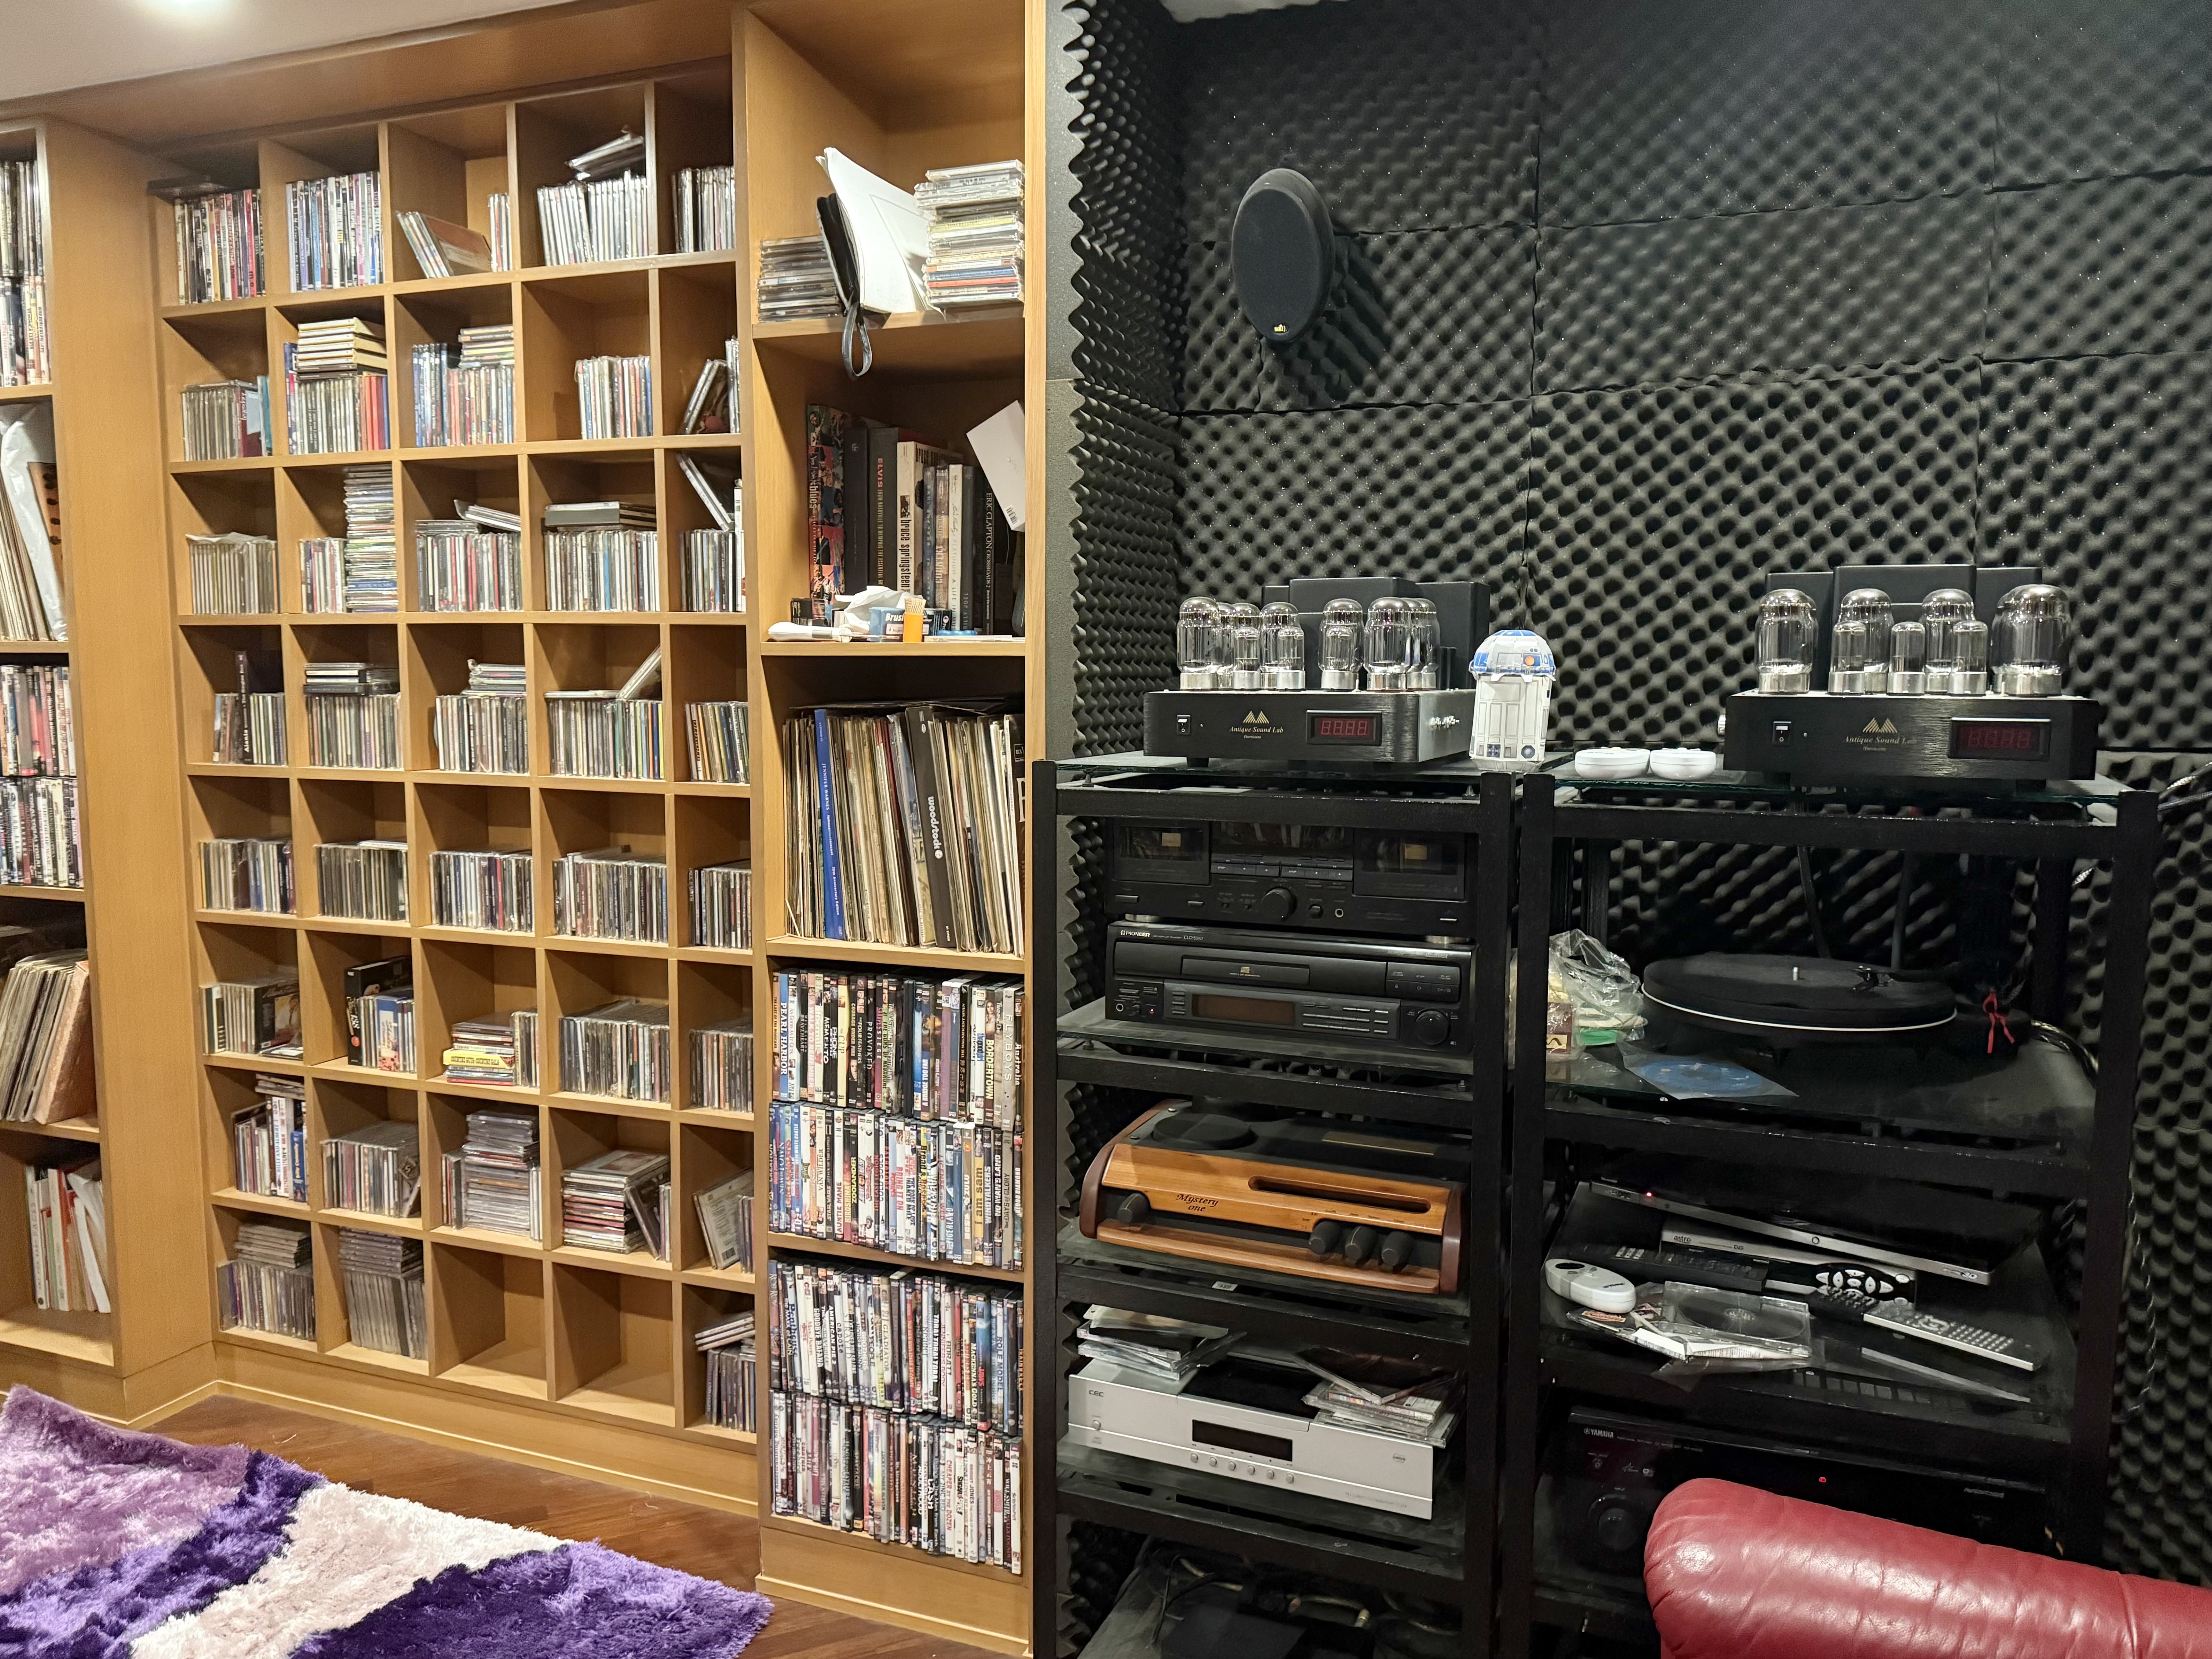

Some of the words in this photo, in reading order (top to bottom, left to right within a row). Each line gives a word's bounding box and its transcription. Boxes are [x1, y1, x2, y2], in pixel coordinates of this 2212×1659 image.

[809, 485, 818, 508] blues
[901, 519, 911, 541] bruce
[899, 544, 911, 587] springsteen
[885, 613, 904, 621] Brus
[1843, 736, 1874, 744] Antique
[927, 796, 942, 849] woodstock
[809, 1032, 814, 1042] TO
[986, 1039, 994, 1099] BORDERTOWN
[896, 1200, 903, 1210] ON
[976, 1198, 982, 1217] am
[1176, 1194, 1219, 1207] Mystery
[995, 1205, 1001, 1216] NO
[790, 1304, 799, 1357] Penthouse
[814, 1308, 822, 1338] GOODBYE
[1591, 1429, 1614, 1439] YAMAHA
